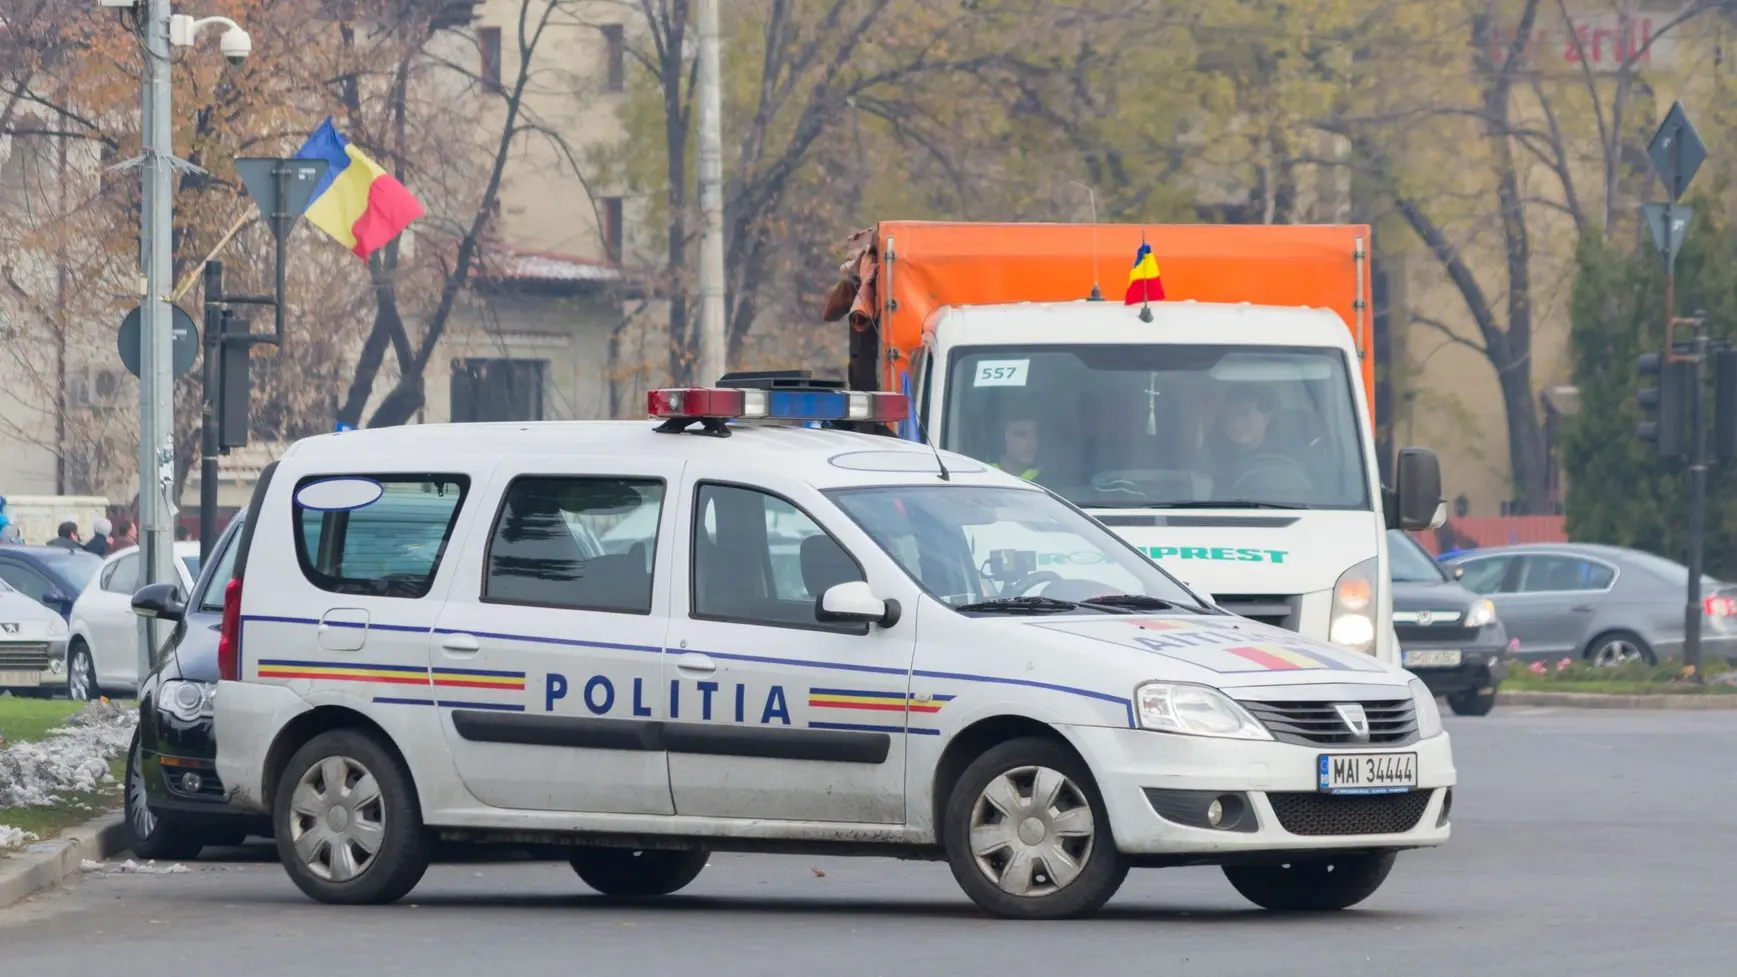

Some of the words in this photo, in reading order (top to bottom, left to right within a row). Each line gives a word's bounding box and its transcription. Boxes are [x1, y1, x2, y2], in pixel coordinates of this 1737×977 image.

[981, 367, 1017, 380] 557
[545, 672, 791, 725] POLITIA
[1333, 757, 1360, 784] MAI
[1366, 756, 1413, 783] 34444
